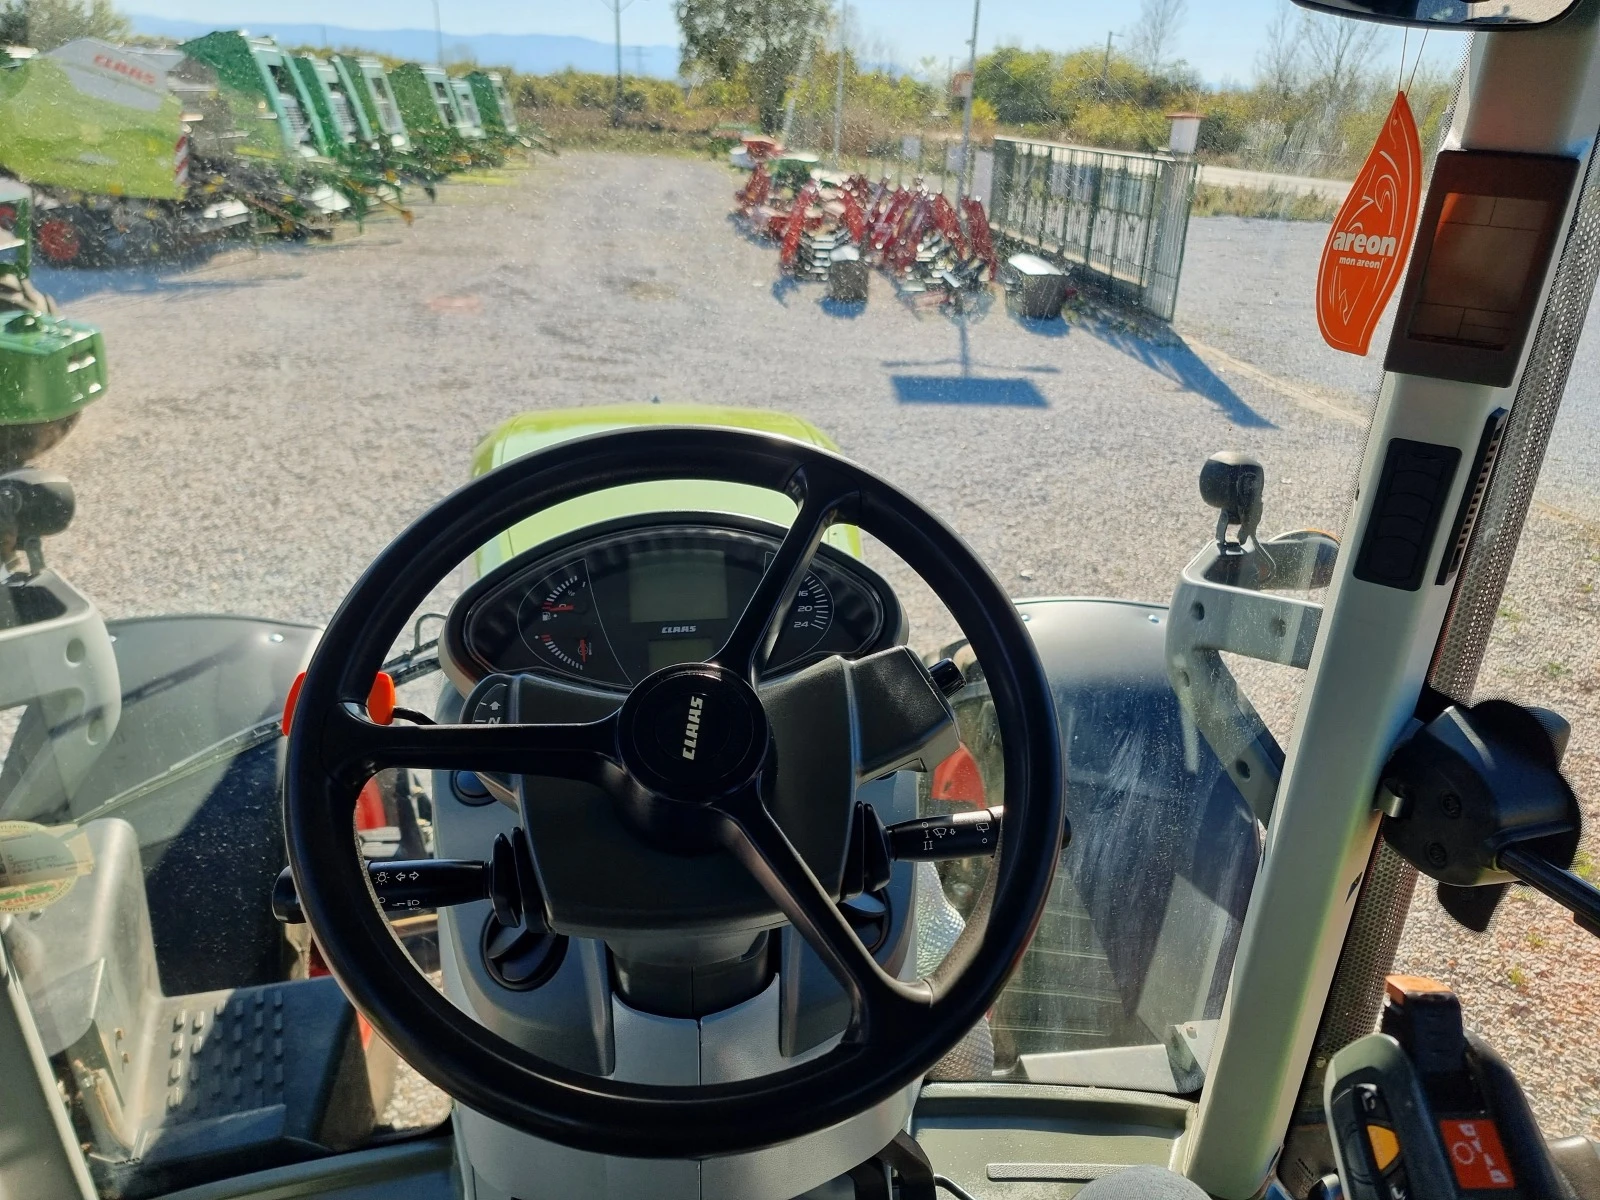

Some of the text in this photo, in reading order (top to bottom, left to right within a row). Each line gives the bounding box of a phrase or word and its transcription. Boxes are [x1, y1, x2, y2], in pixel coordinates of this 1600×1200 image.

[1332, 231, 1397, 257] areon
[1339, 256, 1380, 269] mon areon
[661, 625, 697, 634] CLAAS
[682, 695, 704, 760] CLAAS
